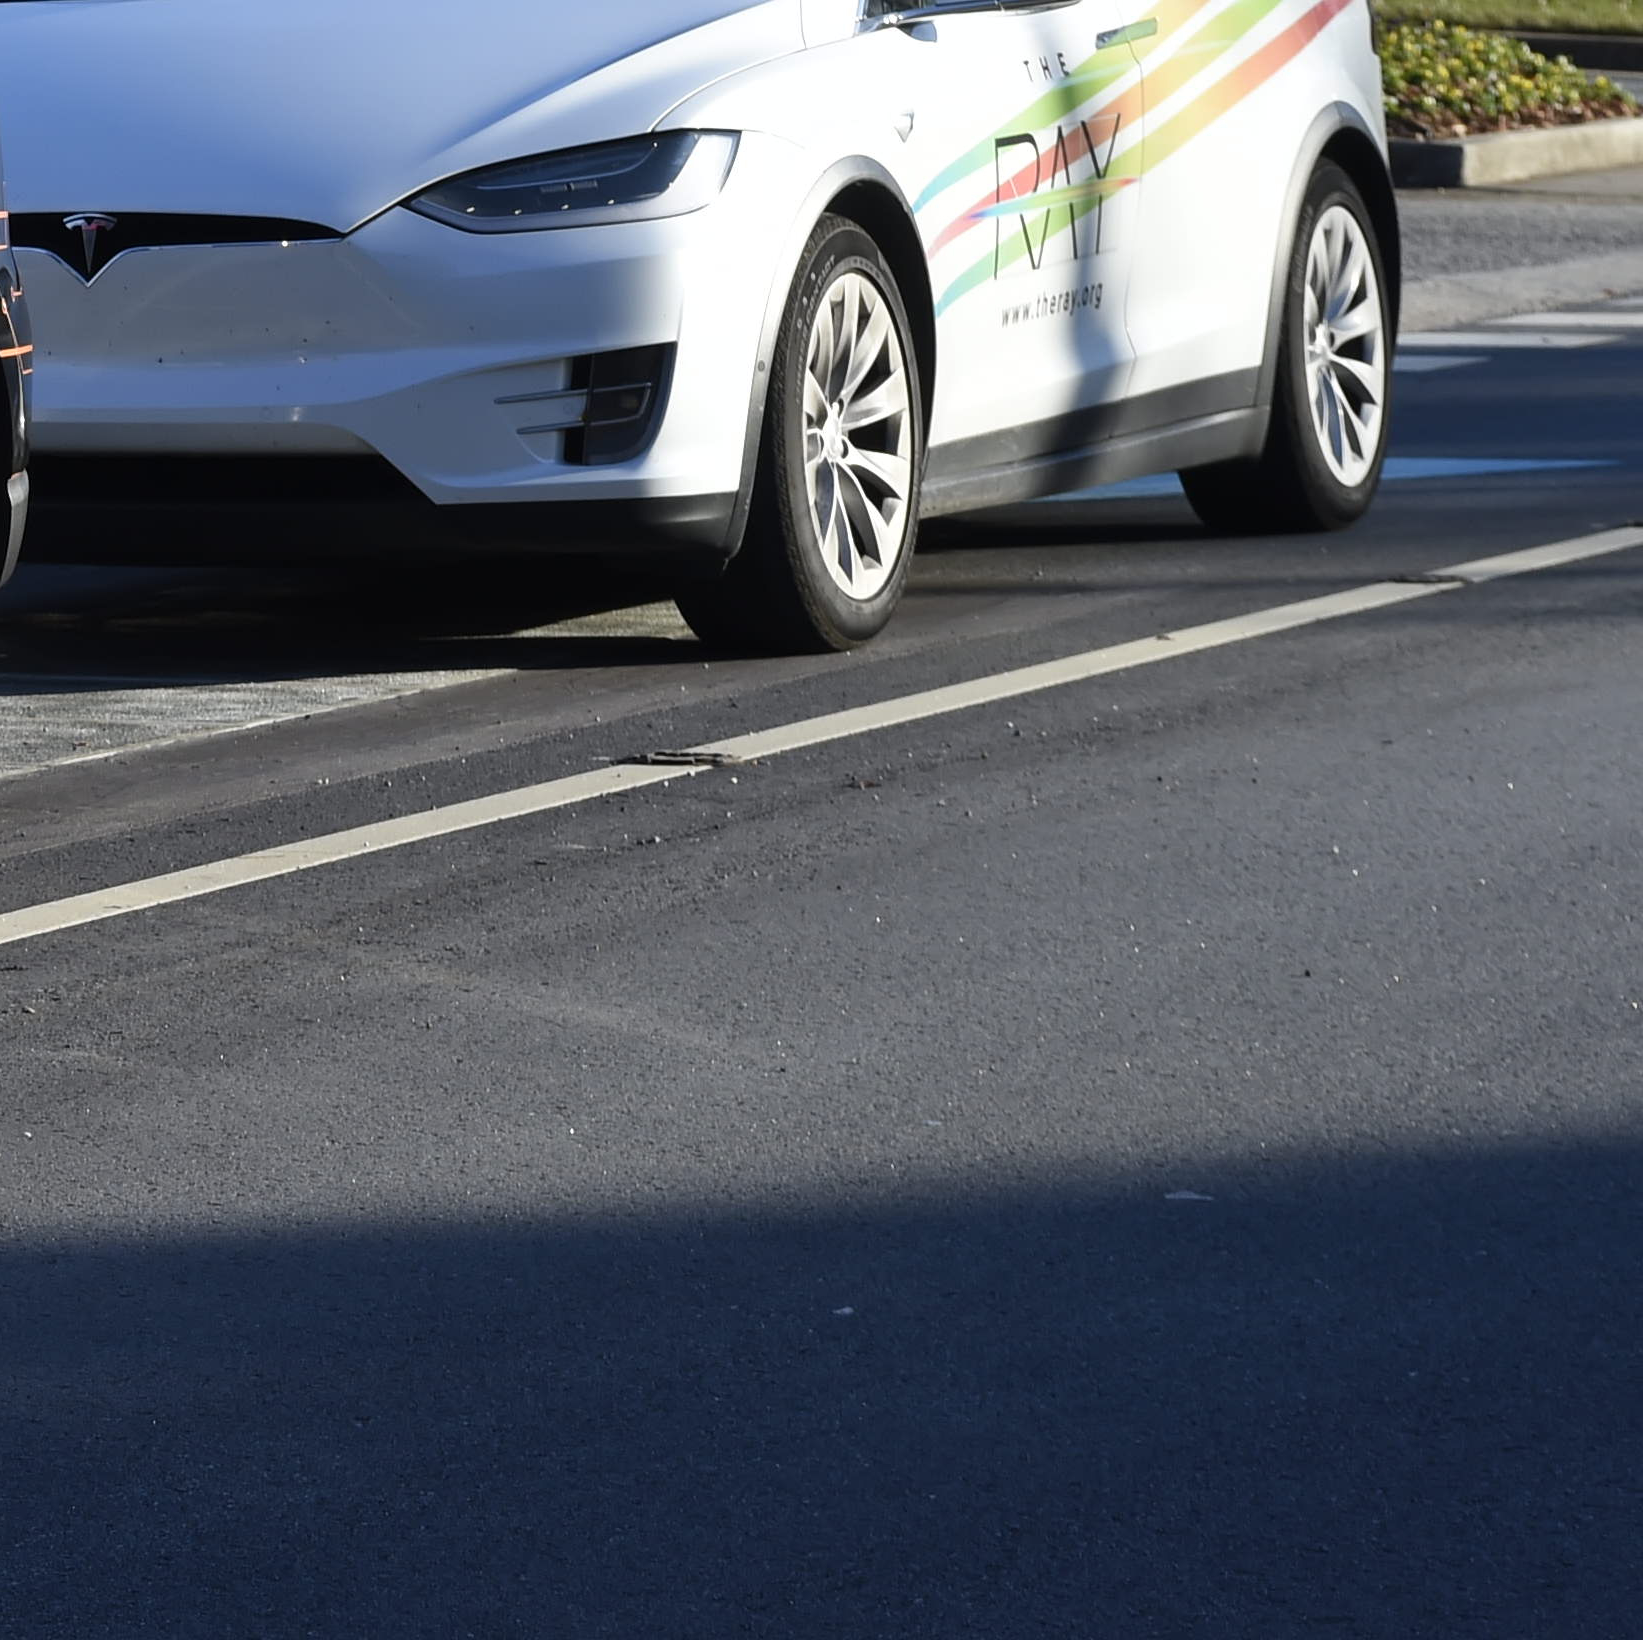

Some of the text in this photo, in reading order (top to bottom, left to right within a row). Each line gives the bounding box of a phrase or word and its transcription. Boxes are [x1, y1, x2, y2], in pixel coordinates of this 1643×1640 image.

[1023, 53, 1070, 82] THE
[994, 113, 1121, 280] RAY
[1001, 282, 1103, 328] www.theray.org
